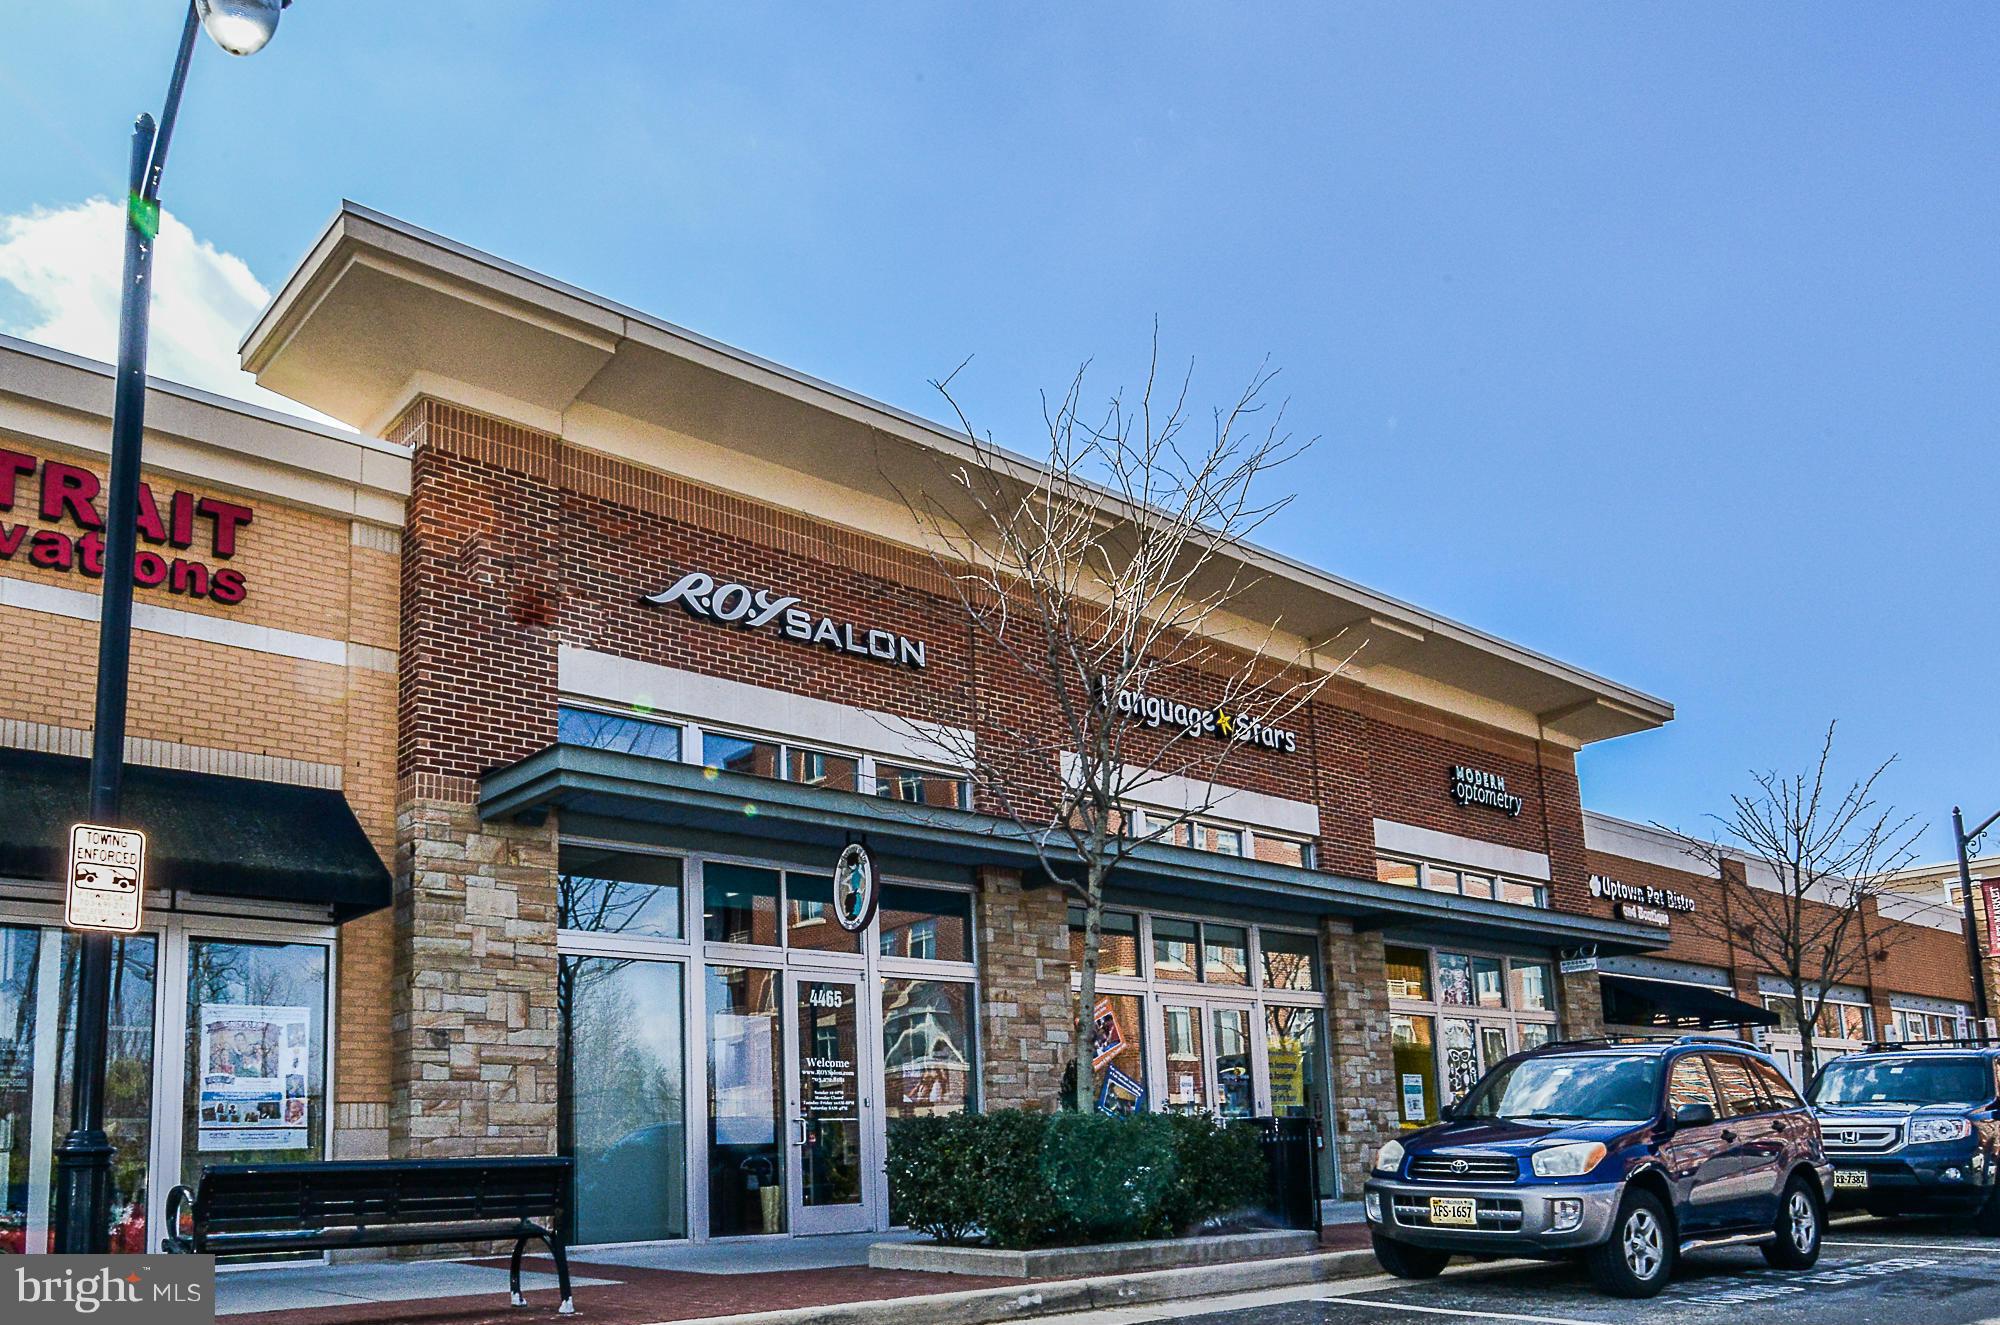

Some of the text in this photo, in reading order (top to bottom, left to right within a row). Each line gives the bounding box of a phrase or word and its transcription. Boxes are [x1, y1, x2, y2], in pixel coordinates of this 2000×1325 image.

[0, 521, 247, 604] vatons
[784, 607, 926, 668] SALON
[1101, 674, 1297, 753] Language Stars
[1455, 765, 1506, 792] MODERN
[1456, 782, 1522, 816] optometry
[87, 831, 128, 848] TOWING
[77, 847, 138, 865] ENFORCED
[1602, 876, 1696, 912] Uptown Pet Bistro
[810, 989, 842, 1008] 4465
[805, 1057, 850, 1068] Welcome
